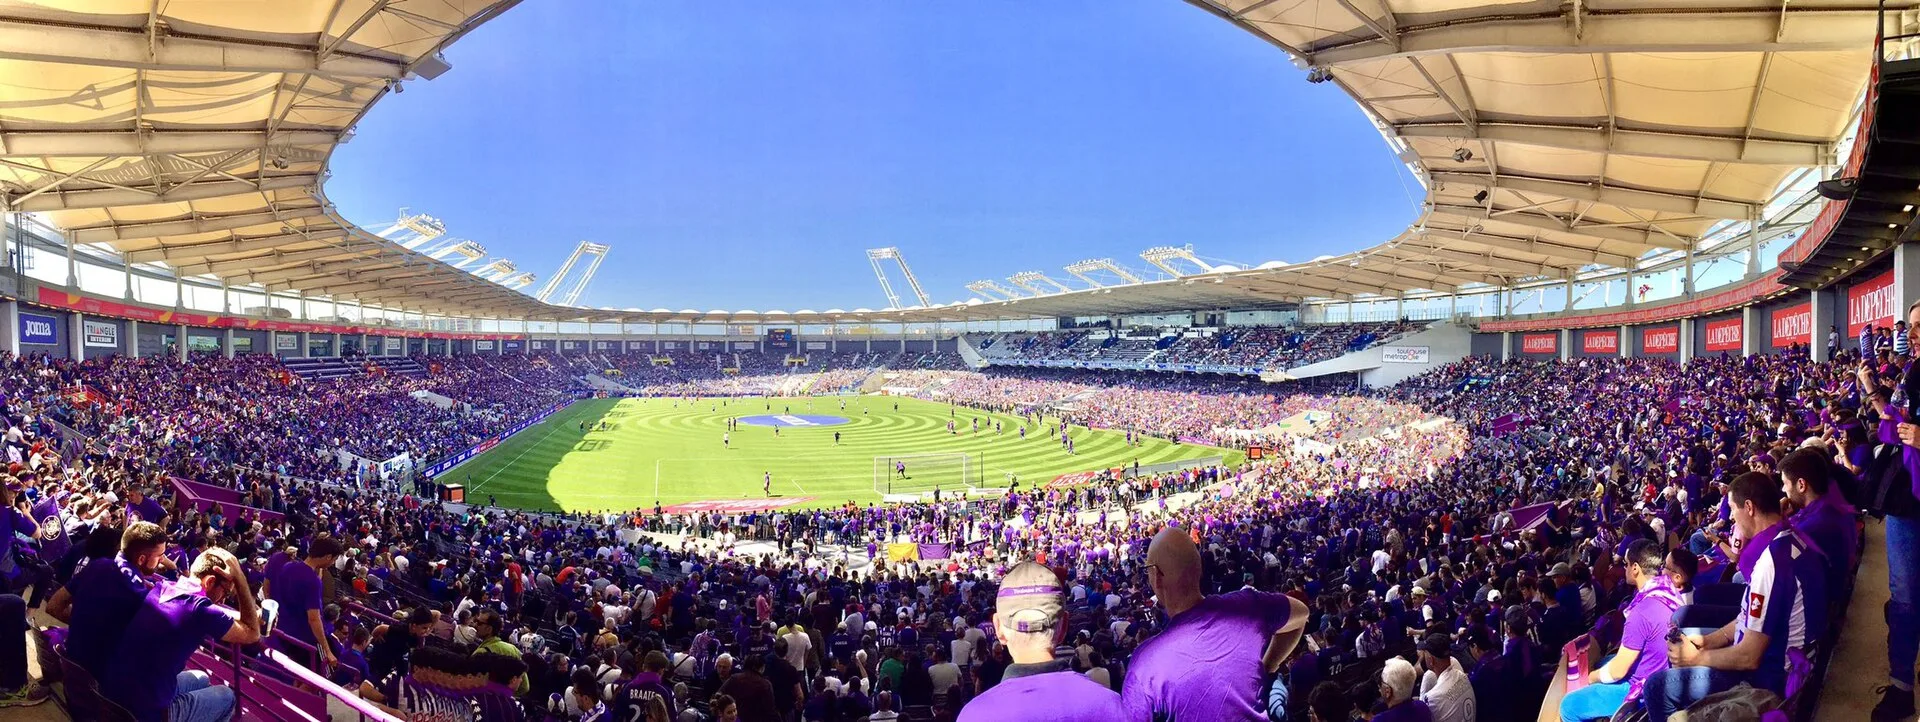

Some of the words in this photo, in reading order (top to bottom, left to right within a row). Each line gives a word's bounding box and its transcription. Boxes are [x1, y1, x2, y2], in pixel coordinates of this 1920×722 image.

[1851, 298, 1860, 325] LA
[86, 324, 115, 336] TRIANGLE
[1774, 318, 1782, 338] LA
[1782, 311, 1810, 337] DÉPÊCHE
[1645, 334, 1653, 347] LA
[1707, 328, 1715, 344] LA
[1715, 325, 1740, 343] DÉPÊCHE
